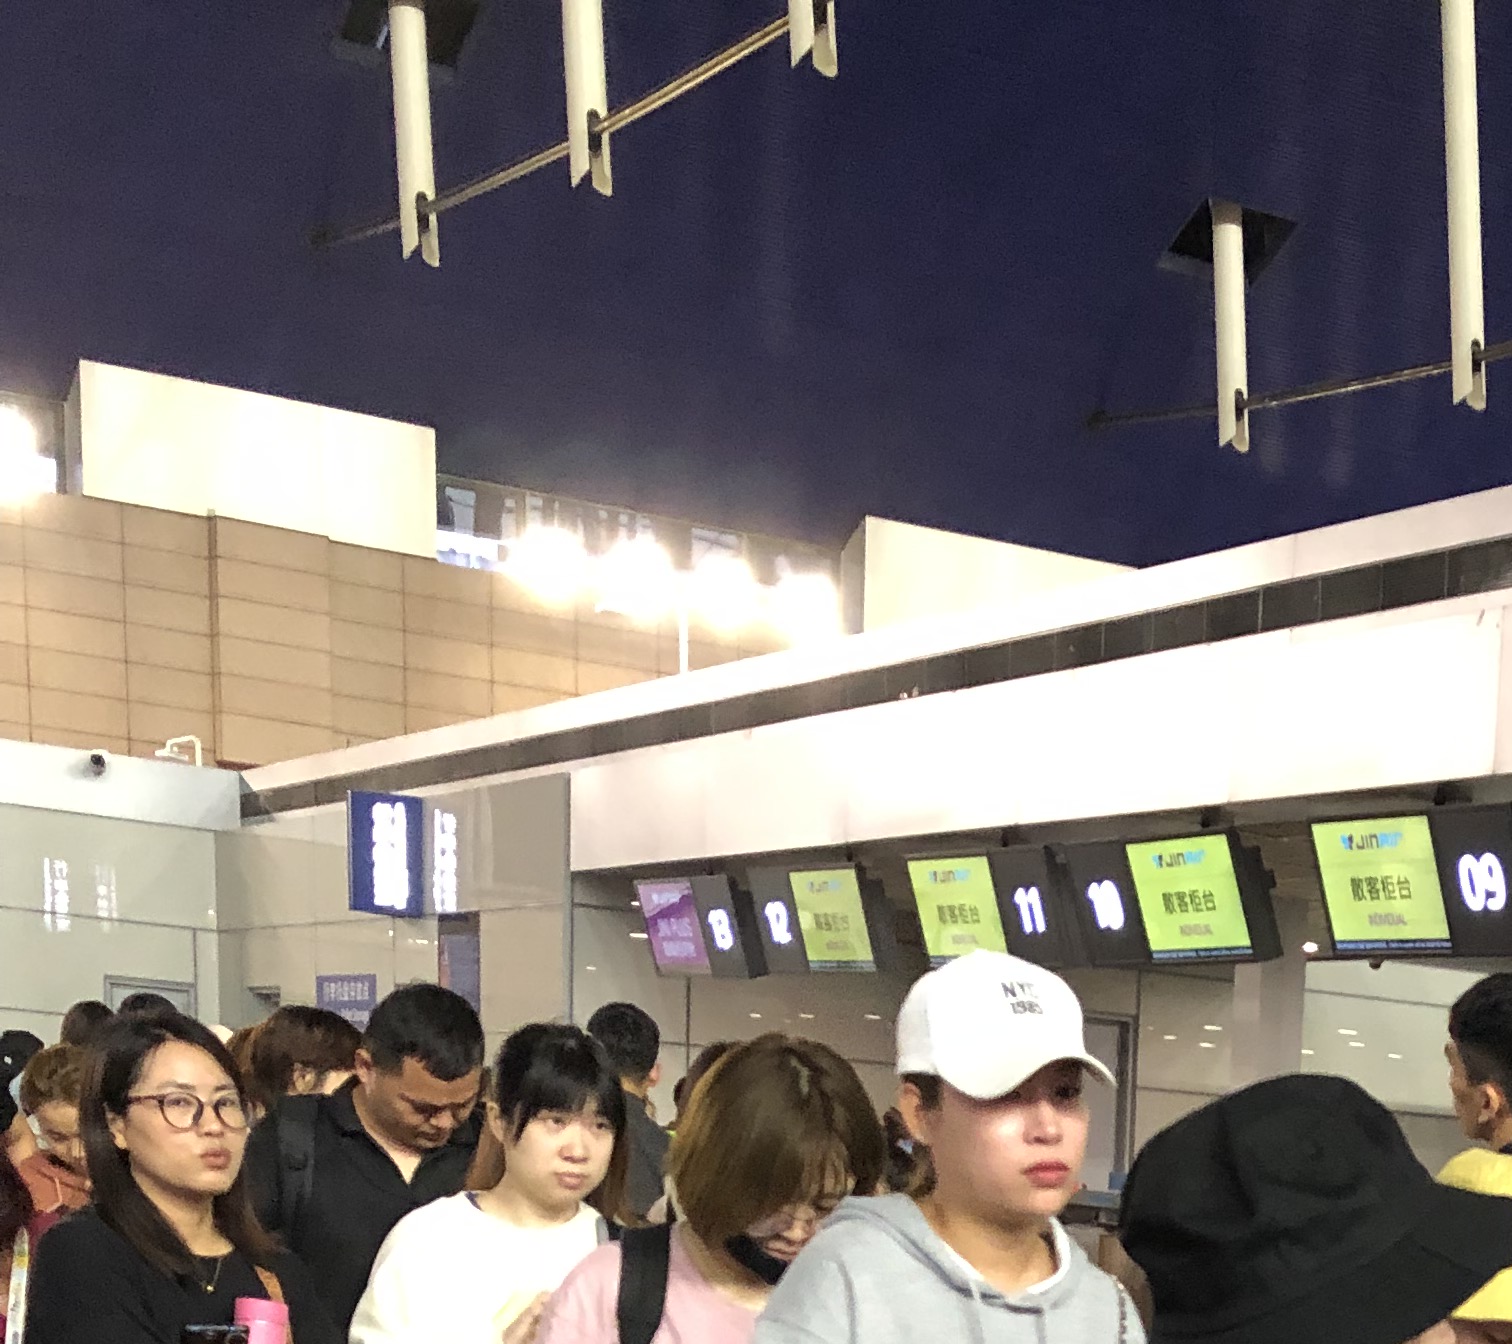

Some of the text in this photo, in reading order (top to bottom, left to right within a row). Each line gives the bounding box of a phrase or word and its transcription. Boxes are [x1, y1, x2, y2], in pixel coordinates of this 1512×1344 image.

[1351, 875, 1412, 902] 散客柜台
[1458, 852, 1507, 911] 09
[1013, 886, 1047, 935] 11
